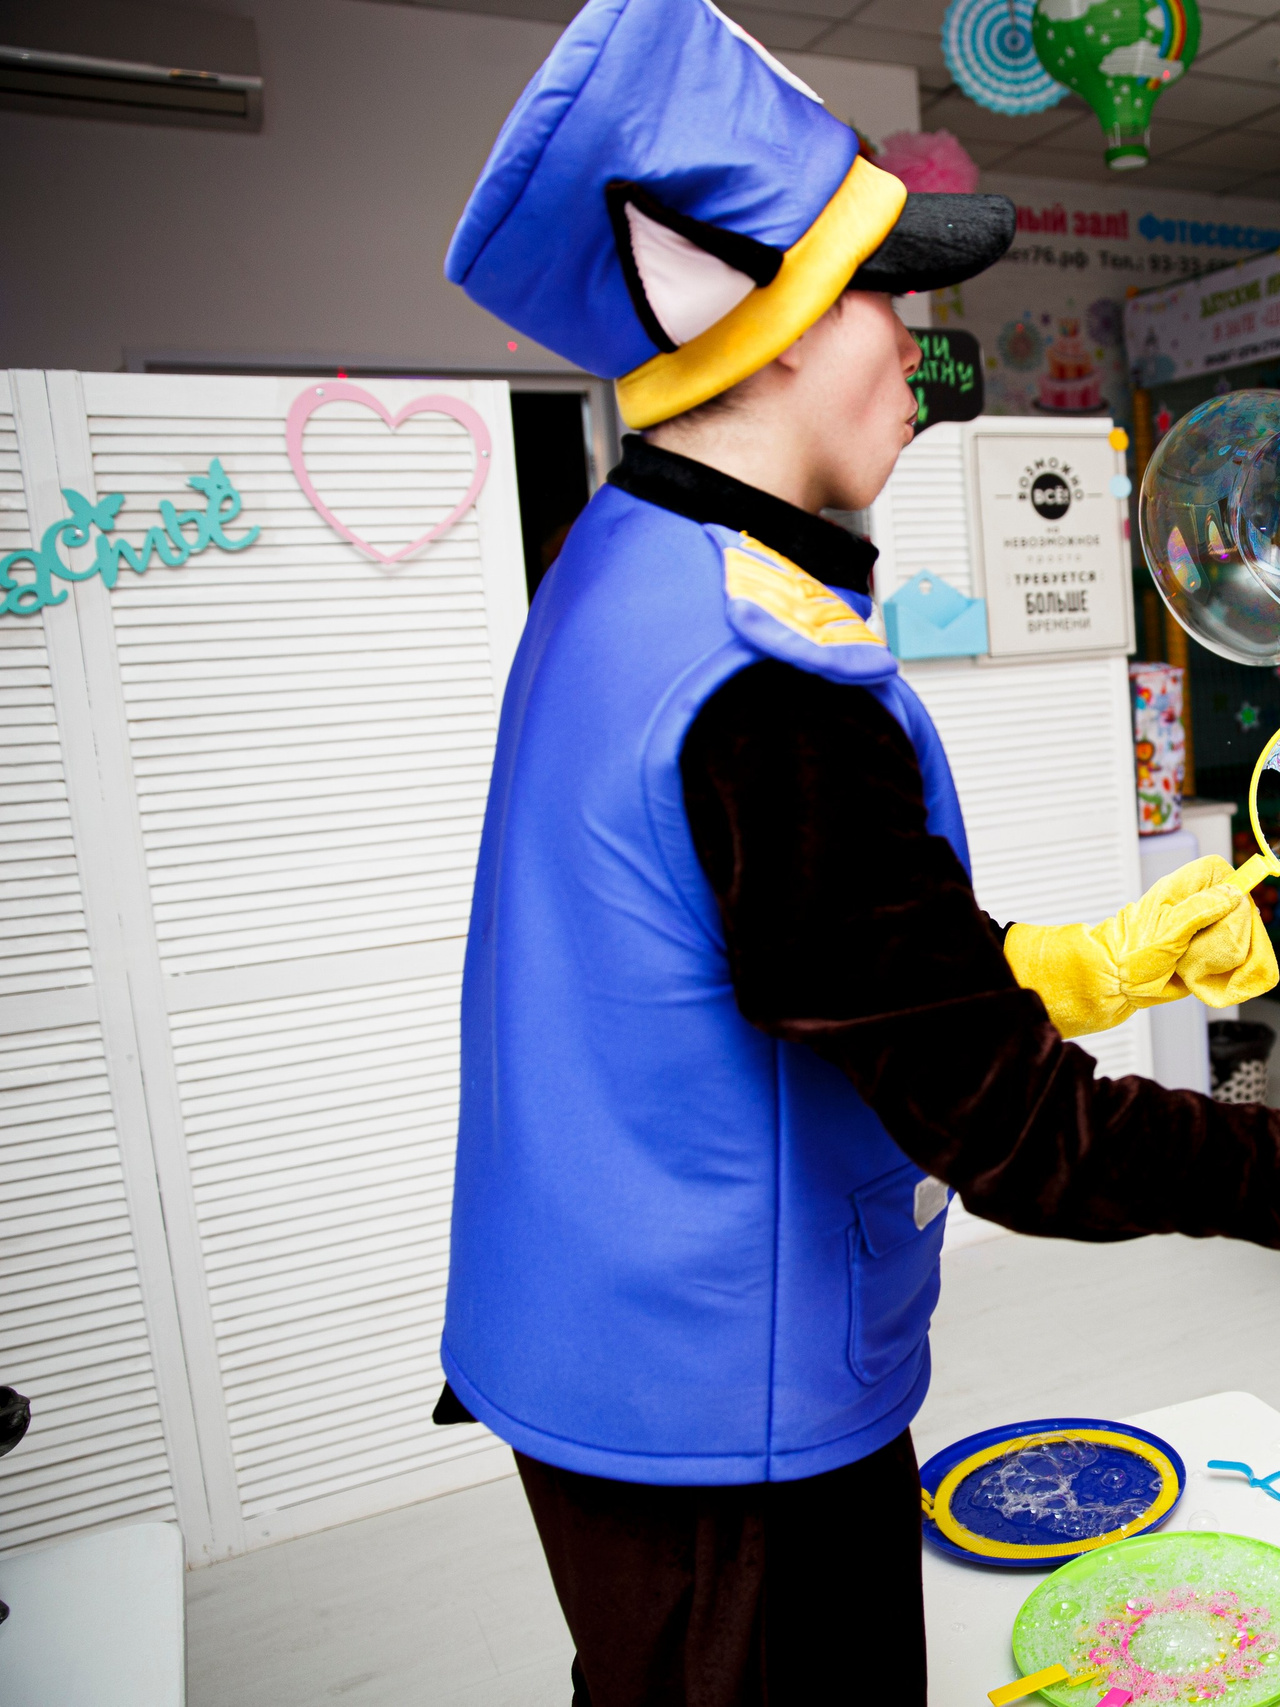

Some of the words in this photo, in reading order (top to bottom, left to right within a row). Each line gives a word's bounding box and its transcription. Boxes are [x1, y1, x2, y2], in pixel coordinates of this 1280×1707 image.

[1073, 209, 1129, 240] зал!
[1018, 456, 1084, 502] ВОЗМОЖНО
[0, 487, 261, 616] астье
[1004, 534, 1100, 549] НЕВОЗМОЖНОЕ
[1014, 570, 1098, 586] ТРЕБУЕТСЯ
[1025, 590, 1089, 615] БОЛЬШЕ
[1027, 616, 1091, 634] ВРЕМЕНИ
